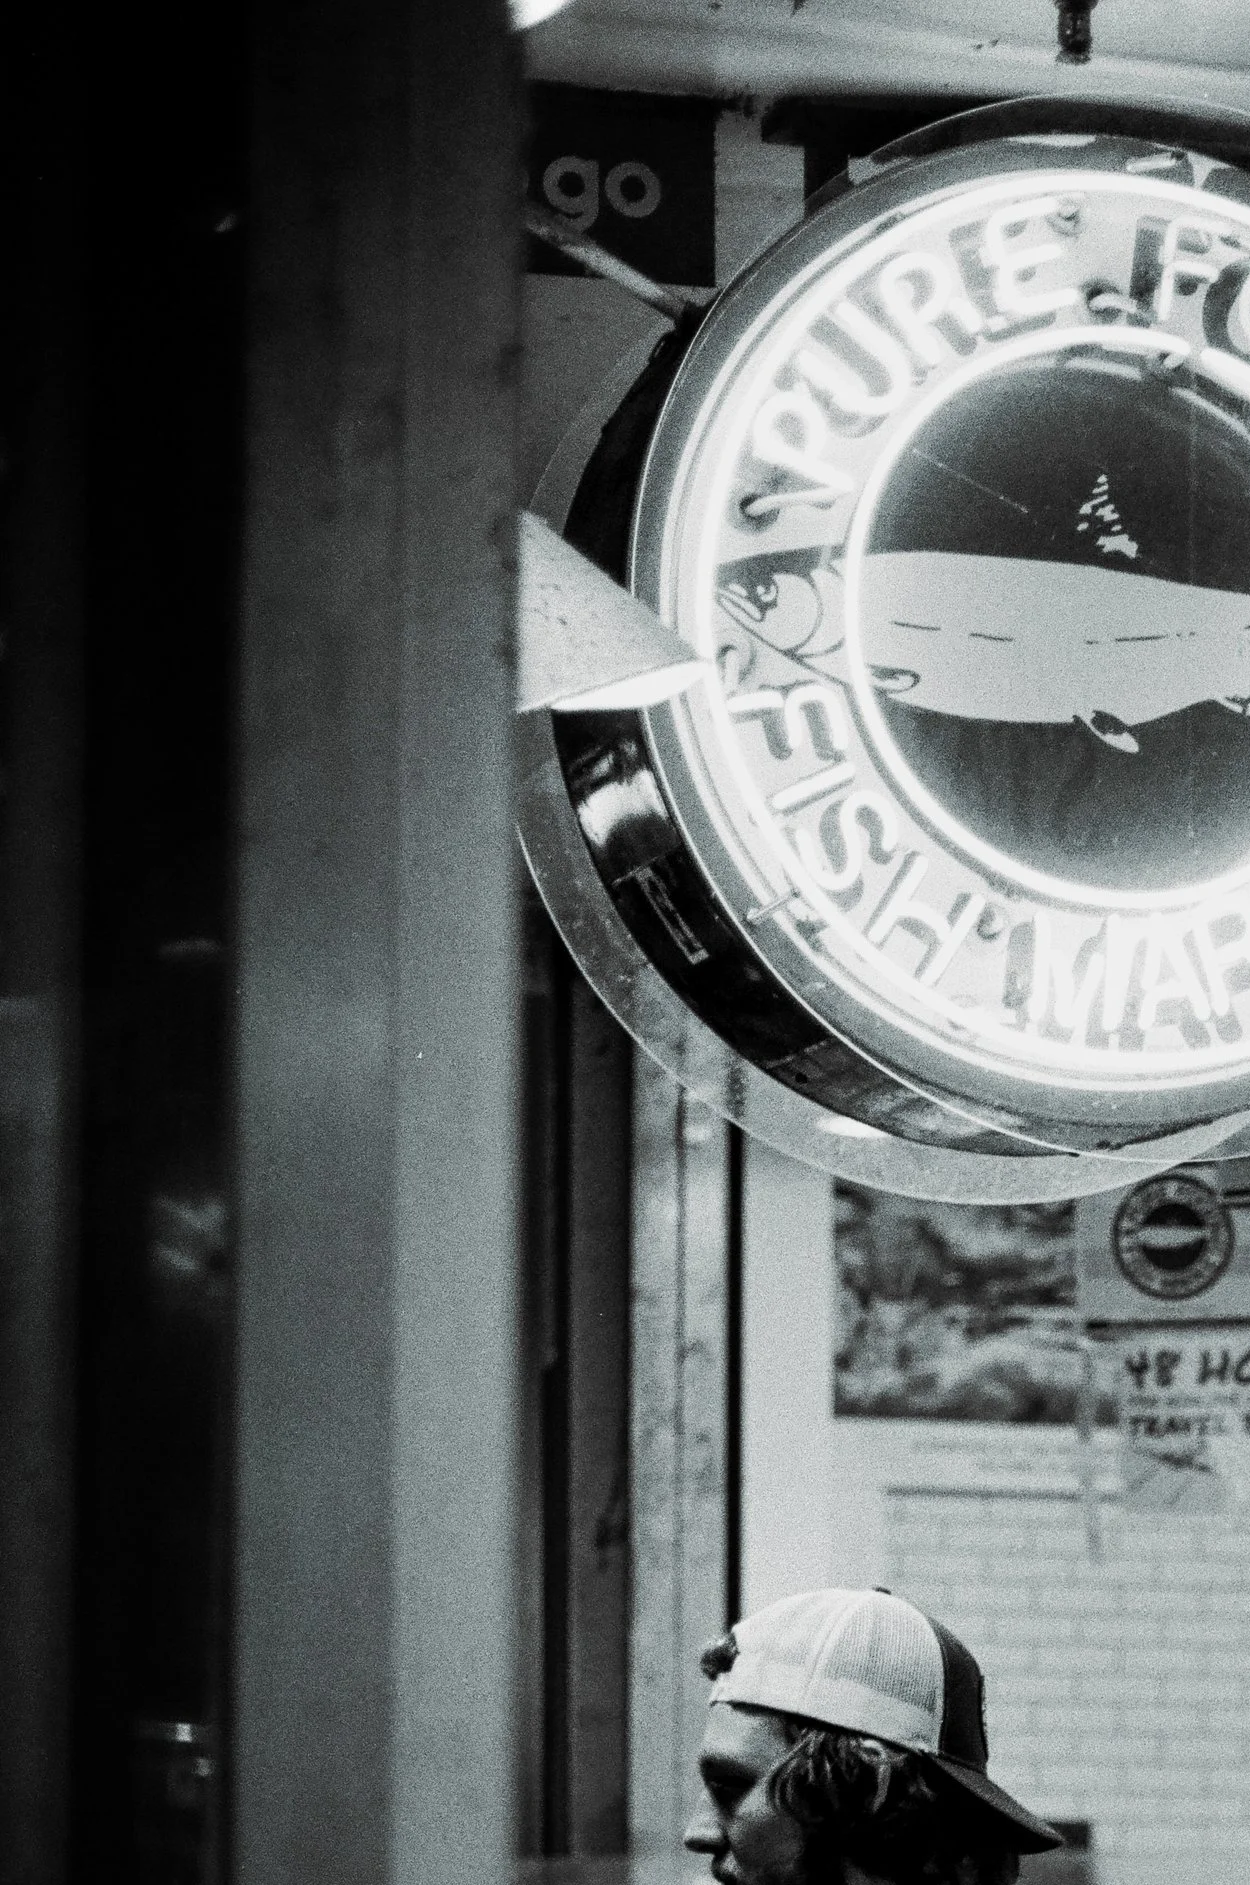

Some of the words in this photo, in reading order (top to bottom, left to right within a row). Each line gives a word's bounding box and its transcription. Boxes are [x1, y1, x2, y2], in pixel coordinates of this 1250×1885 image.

[542, 155, 662, 235] go
[745, 198, 1082, 505] PURE
[726, 683, 984, 988] FISH
[1125, 1350, 1181, 1388] 48
